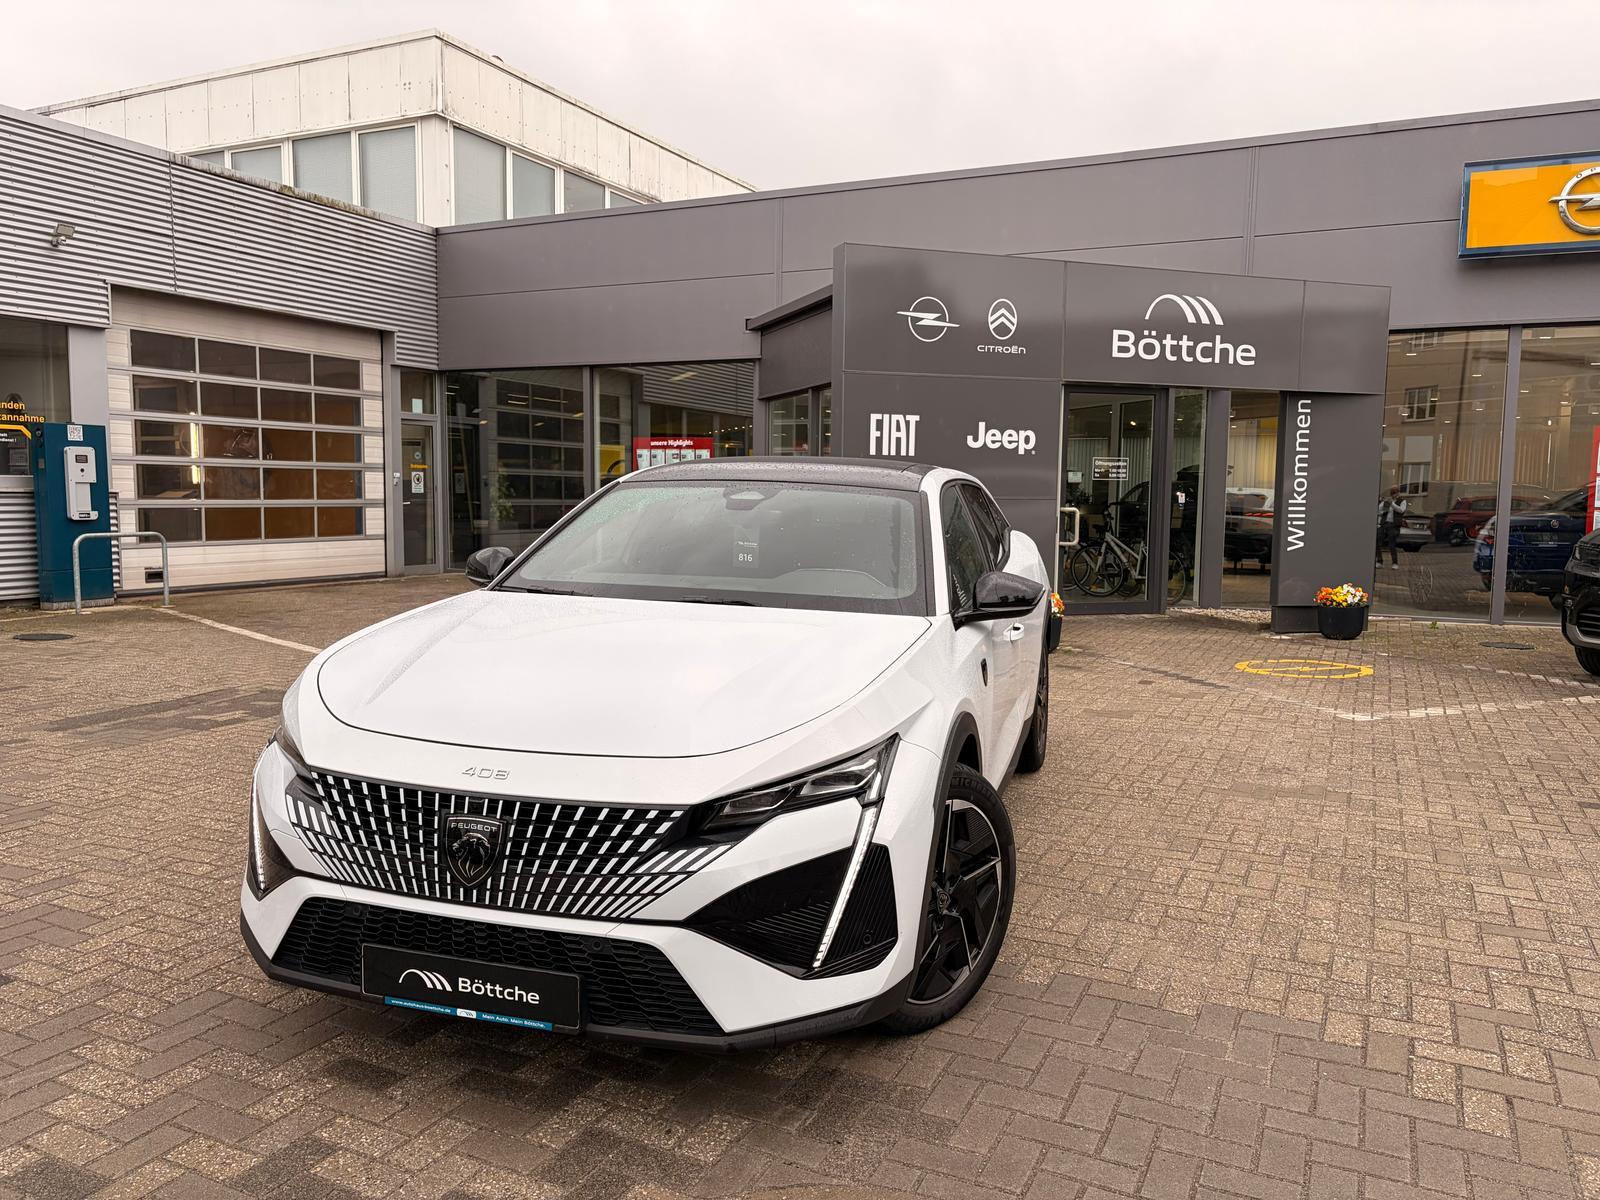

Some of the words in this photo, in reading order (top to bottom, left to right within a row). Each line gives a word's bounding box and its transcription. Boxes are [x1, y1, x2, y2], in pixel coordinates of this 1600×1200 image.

[1112, 329, 1256, 366] Böttche
[668, 439, 693, 447] Highlights
[869, 413, 920, 457] FIAT
[966, 422, 1036, 455] Jeep
[1286, 399, 1312, 551] Willkommen
[738, 553, 753, 562] 816
[461, 767, 510, 780] 408
[451, 822, 498, 833] PEUGEOT
[458, 977, 540, 1004] Böttche
